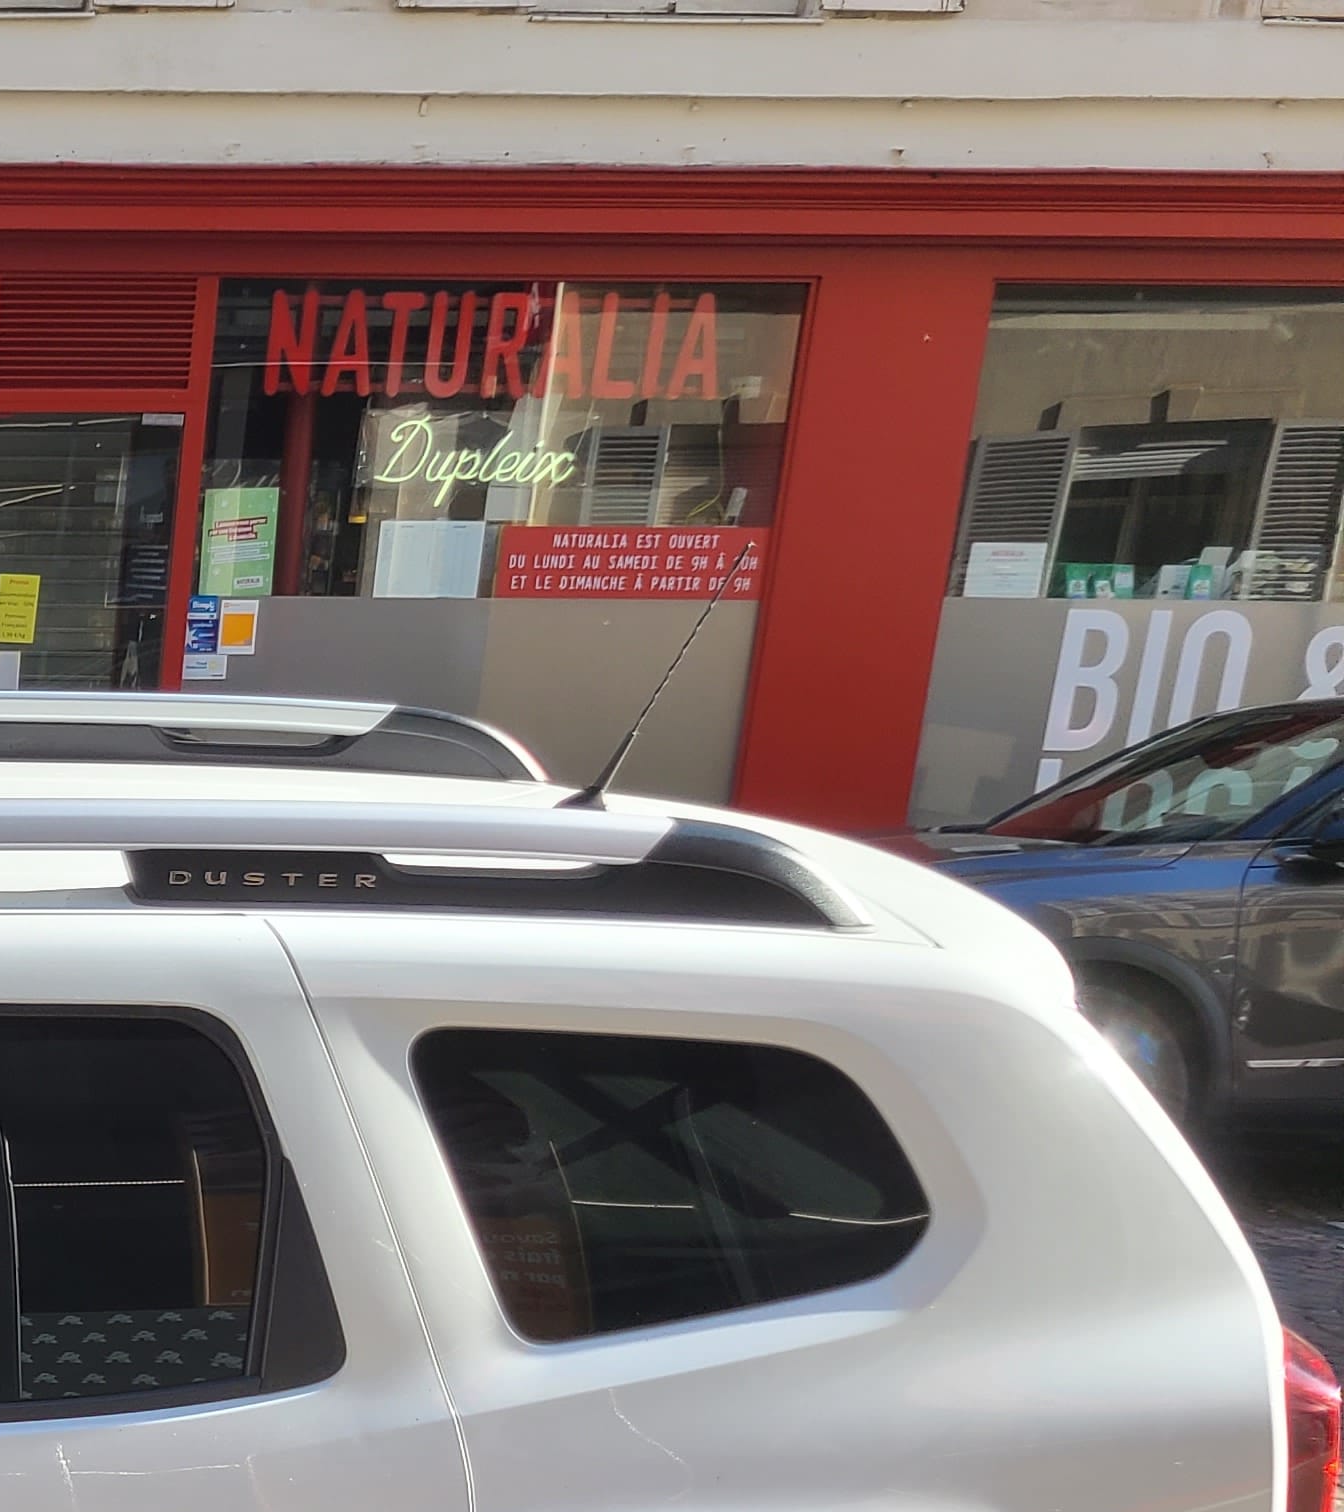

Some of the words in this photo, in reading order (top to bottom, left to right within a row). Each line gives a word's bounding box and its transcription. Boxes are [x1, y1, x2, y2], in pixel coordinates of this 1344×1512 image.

[263, 289, 719, 400] NATURALIA
[374, 415, 575, 508] Dupleix
[552, 534, 628, 549] NATURALIA
[636, 534, 661, 549] EST
[669, 535, 720, 549] OUVERT
[509, 554, 526, 569] DU
[533, 554, 575, 569] LUNDI
[583, 555, 600, 569] AU
[608, 555, 659, 570] SAMEDI
[666, 555, 684, 570] DE
[691, 555, 709, 571] 9H
[733, 555, 759, 570] 0H
[510, 575, 528, 590] ET
[535, 575, 553, 590] LE
[559, 575, 628, 591] DIMANCHE
[650, 576, 701, 592] PARTIR
[734, 577, 752, 593] 9H
[1042, 608, 1253, 751] BIO
[168, 869, 377, 888] DUSTER
